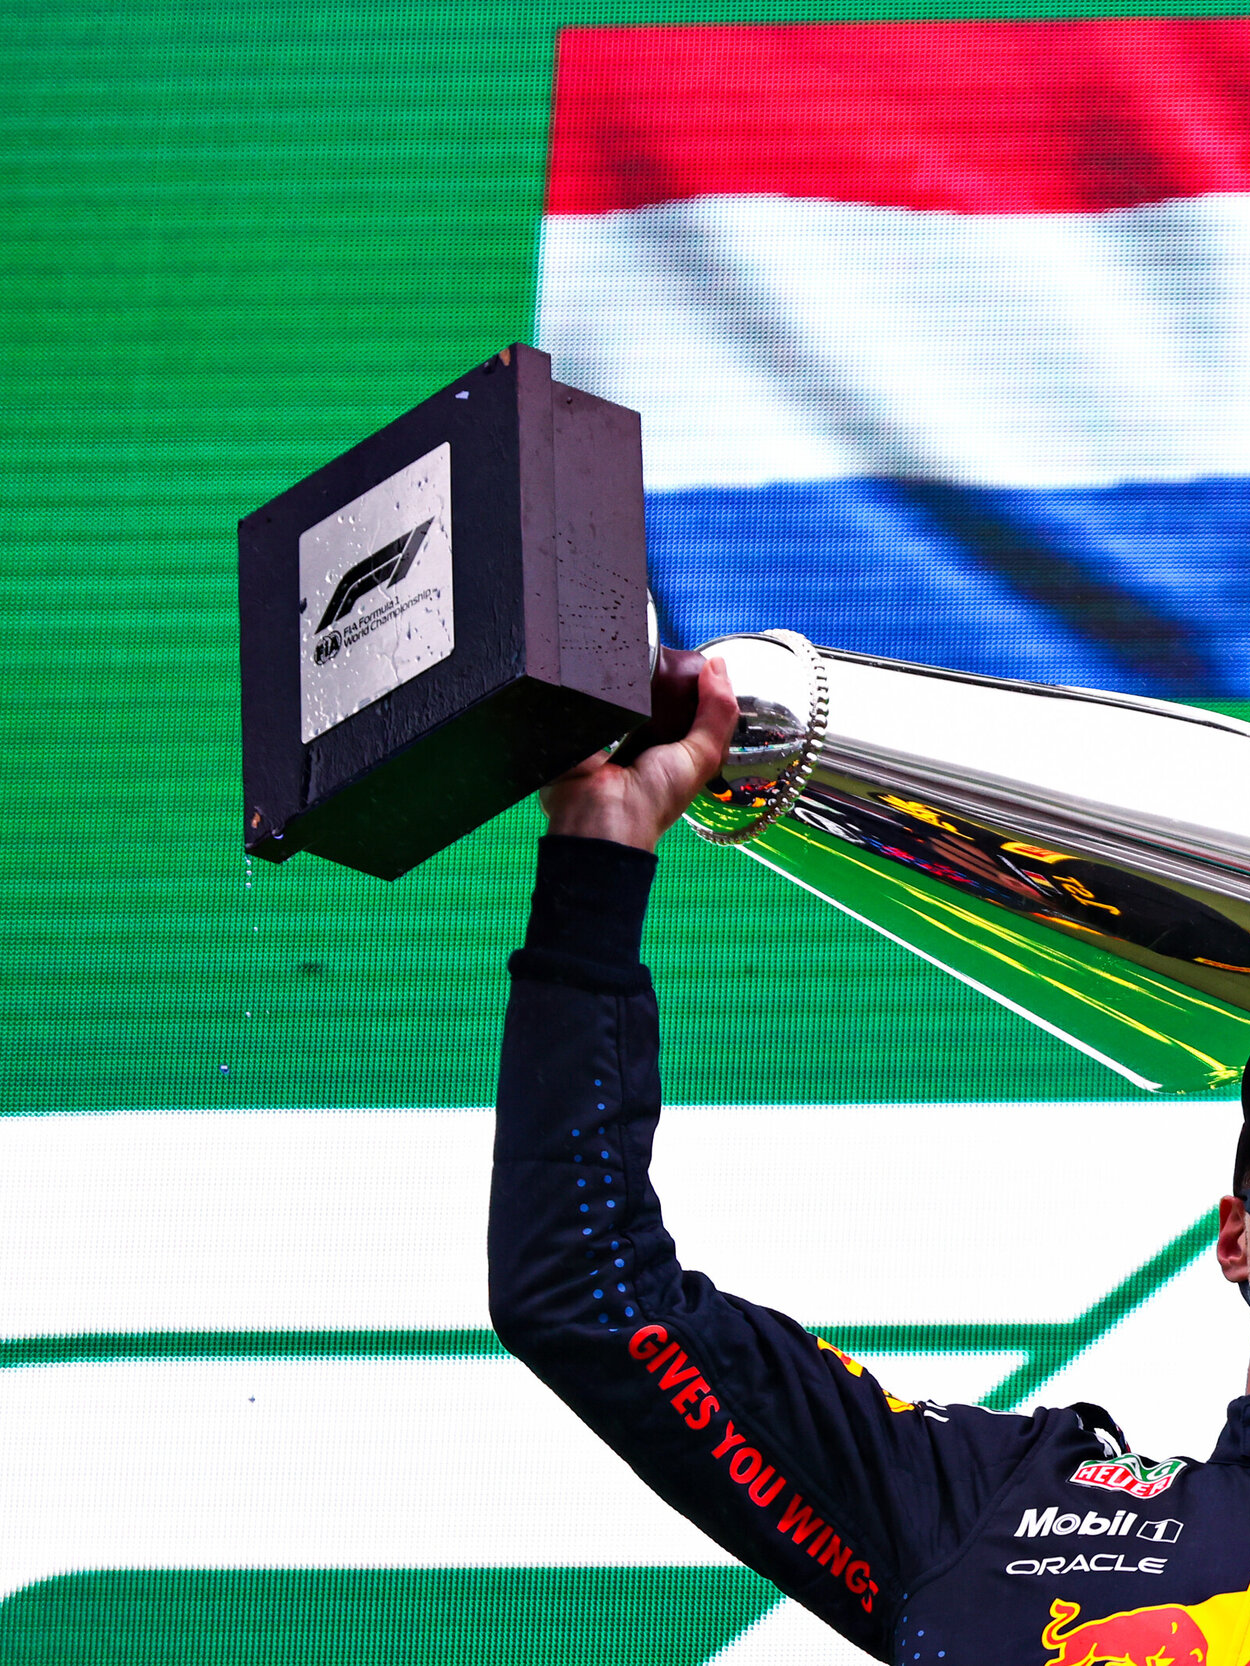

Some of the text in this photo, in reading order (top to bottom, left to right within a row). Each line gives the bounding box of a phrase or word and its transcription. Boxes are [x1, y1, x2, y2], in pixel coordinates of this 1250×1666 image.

[314, 516, 435, 635] F1
[344, 589, 432, 648] World Championship
[344, 623, 358, 638] FIA
[359, 602, 394, 626] Formula
[315, 634, 341, 662] FIA
[628, 1324, 880, 1614] GIVES YOU WINGS
[1079, 1466, 1167, 1495] HEUER
[1014, 1507, 1138, 1537] Mobil
[1006, 1554, 1168, 1576] ORACLE
